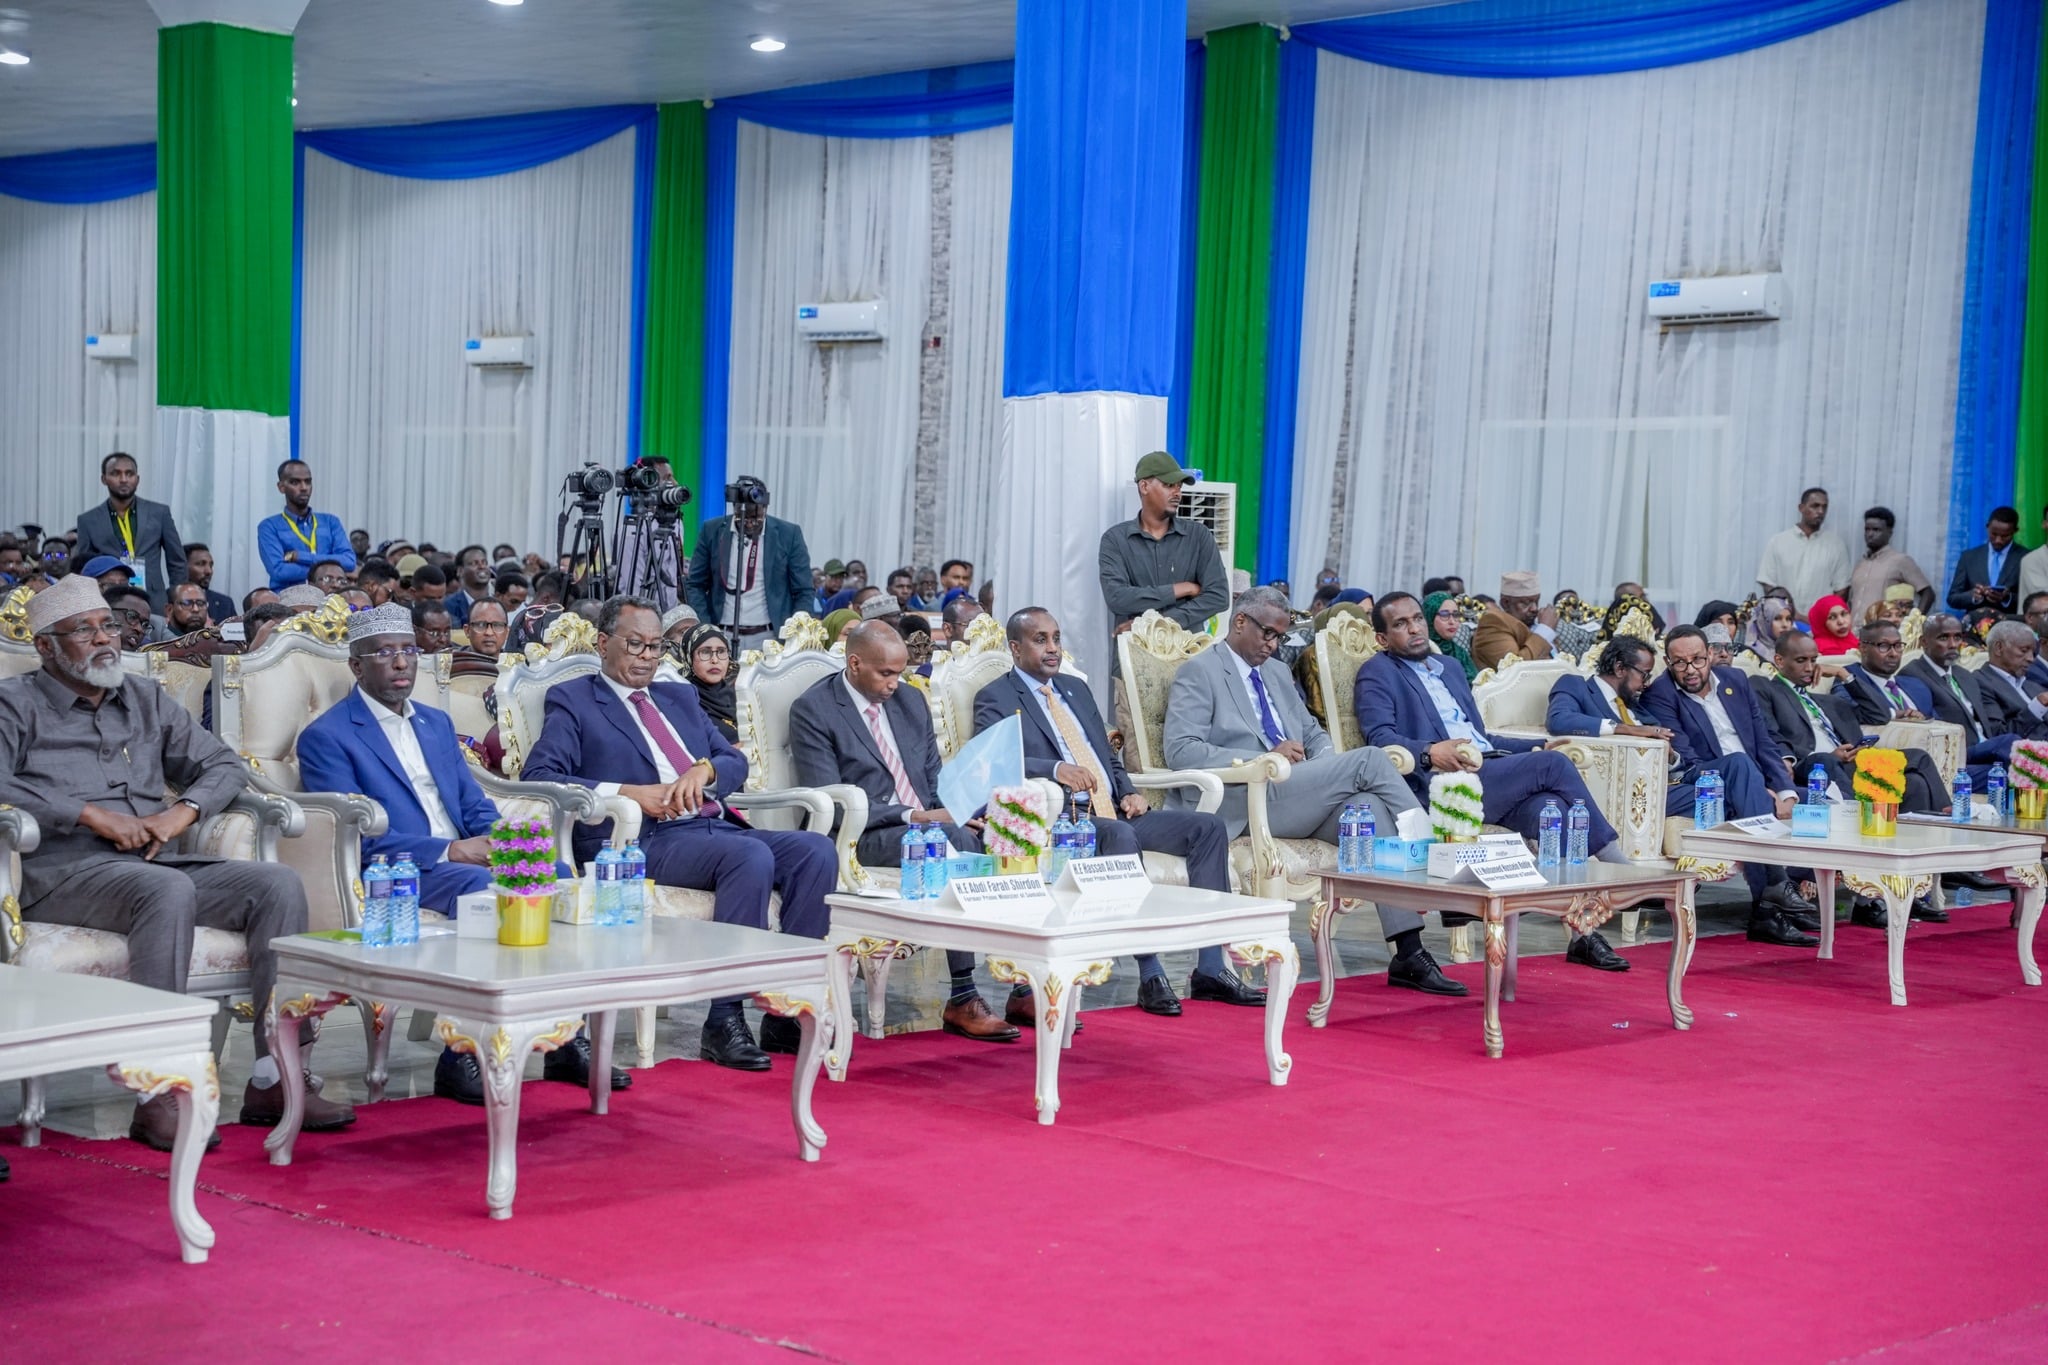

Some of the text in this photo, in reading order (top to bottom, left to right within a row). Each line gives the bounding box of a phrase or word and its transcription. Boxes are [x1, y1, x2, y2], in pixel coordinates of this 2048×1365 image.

[969, 881, 988, 894] Abdi
[987, 880, 1010, 892] Farah
[1010, 878, 1041, 891] Shirdon
